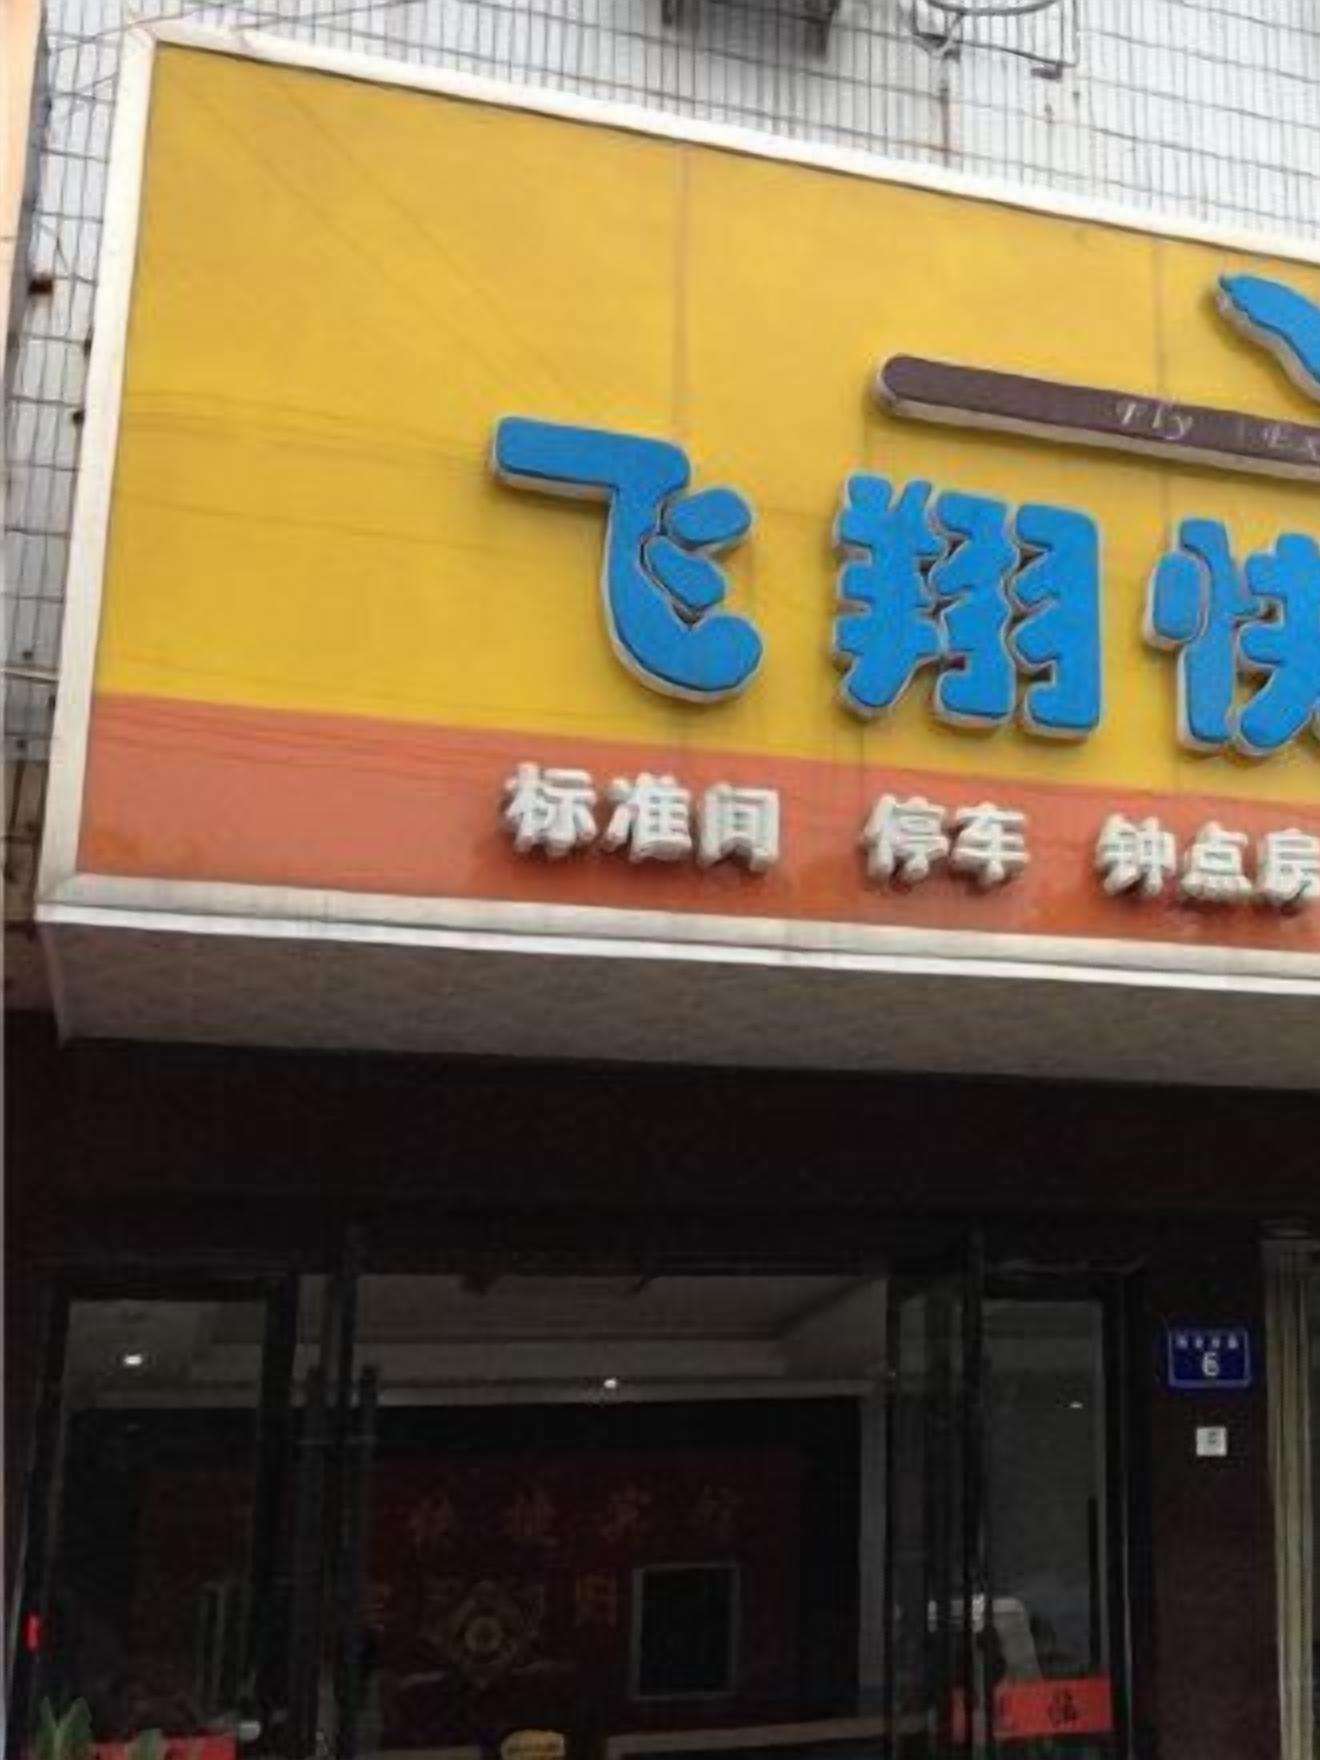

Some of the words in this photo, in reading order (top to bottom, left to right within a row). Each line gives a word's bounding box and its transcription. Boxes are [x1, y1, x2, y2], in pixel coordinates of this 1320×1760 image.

[1112, 402, 1194, 440] Fly
[503, 762, 782, 872] 标准间
[862, 793, 1030, 884] 停车
[1201, 1350, 1221, 1378] 6
